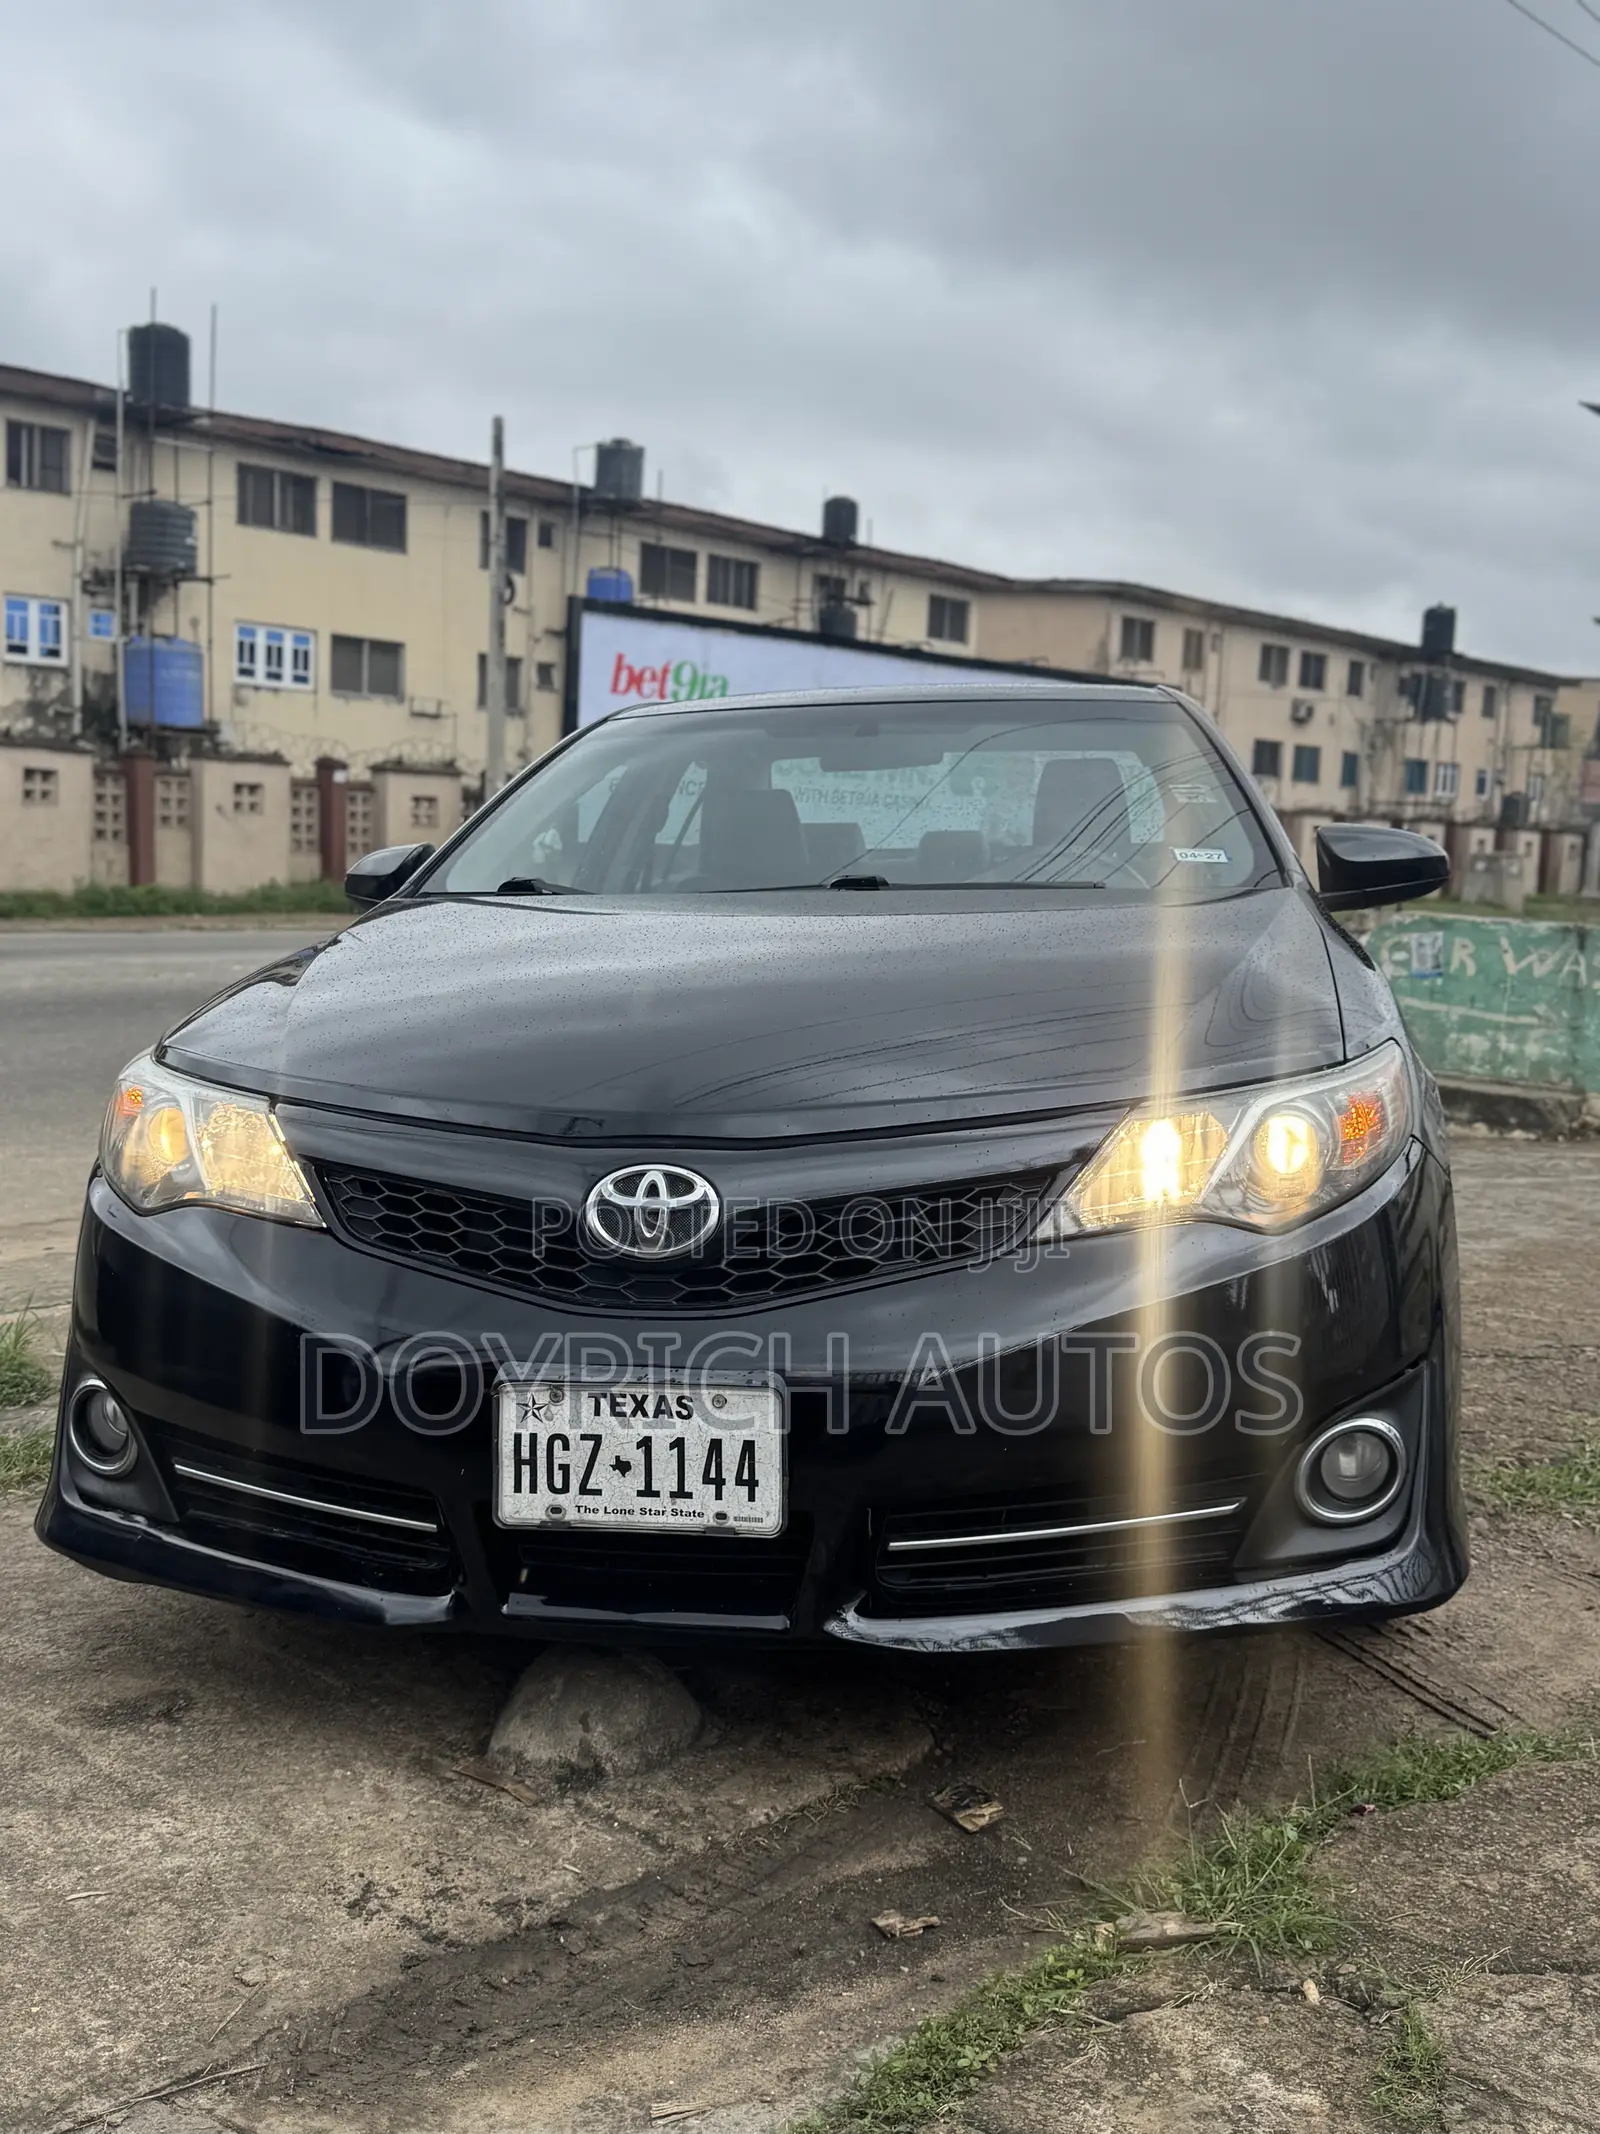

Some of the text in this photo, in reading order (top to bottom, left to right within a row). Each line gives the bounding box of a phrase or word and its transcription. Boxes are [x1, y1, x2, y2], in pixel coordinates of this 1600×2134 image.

[587, 1392, 694, 1421] TEXAS
[513, 1432, 759, 1502] HGZ 1144
[575, 1505, 705, 1518] The Lone Star State
